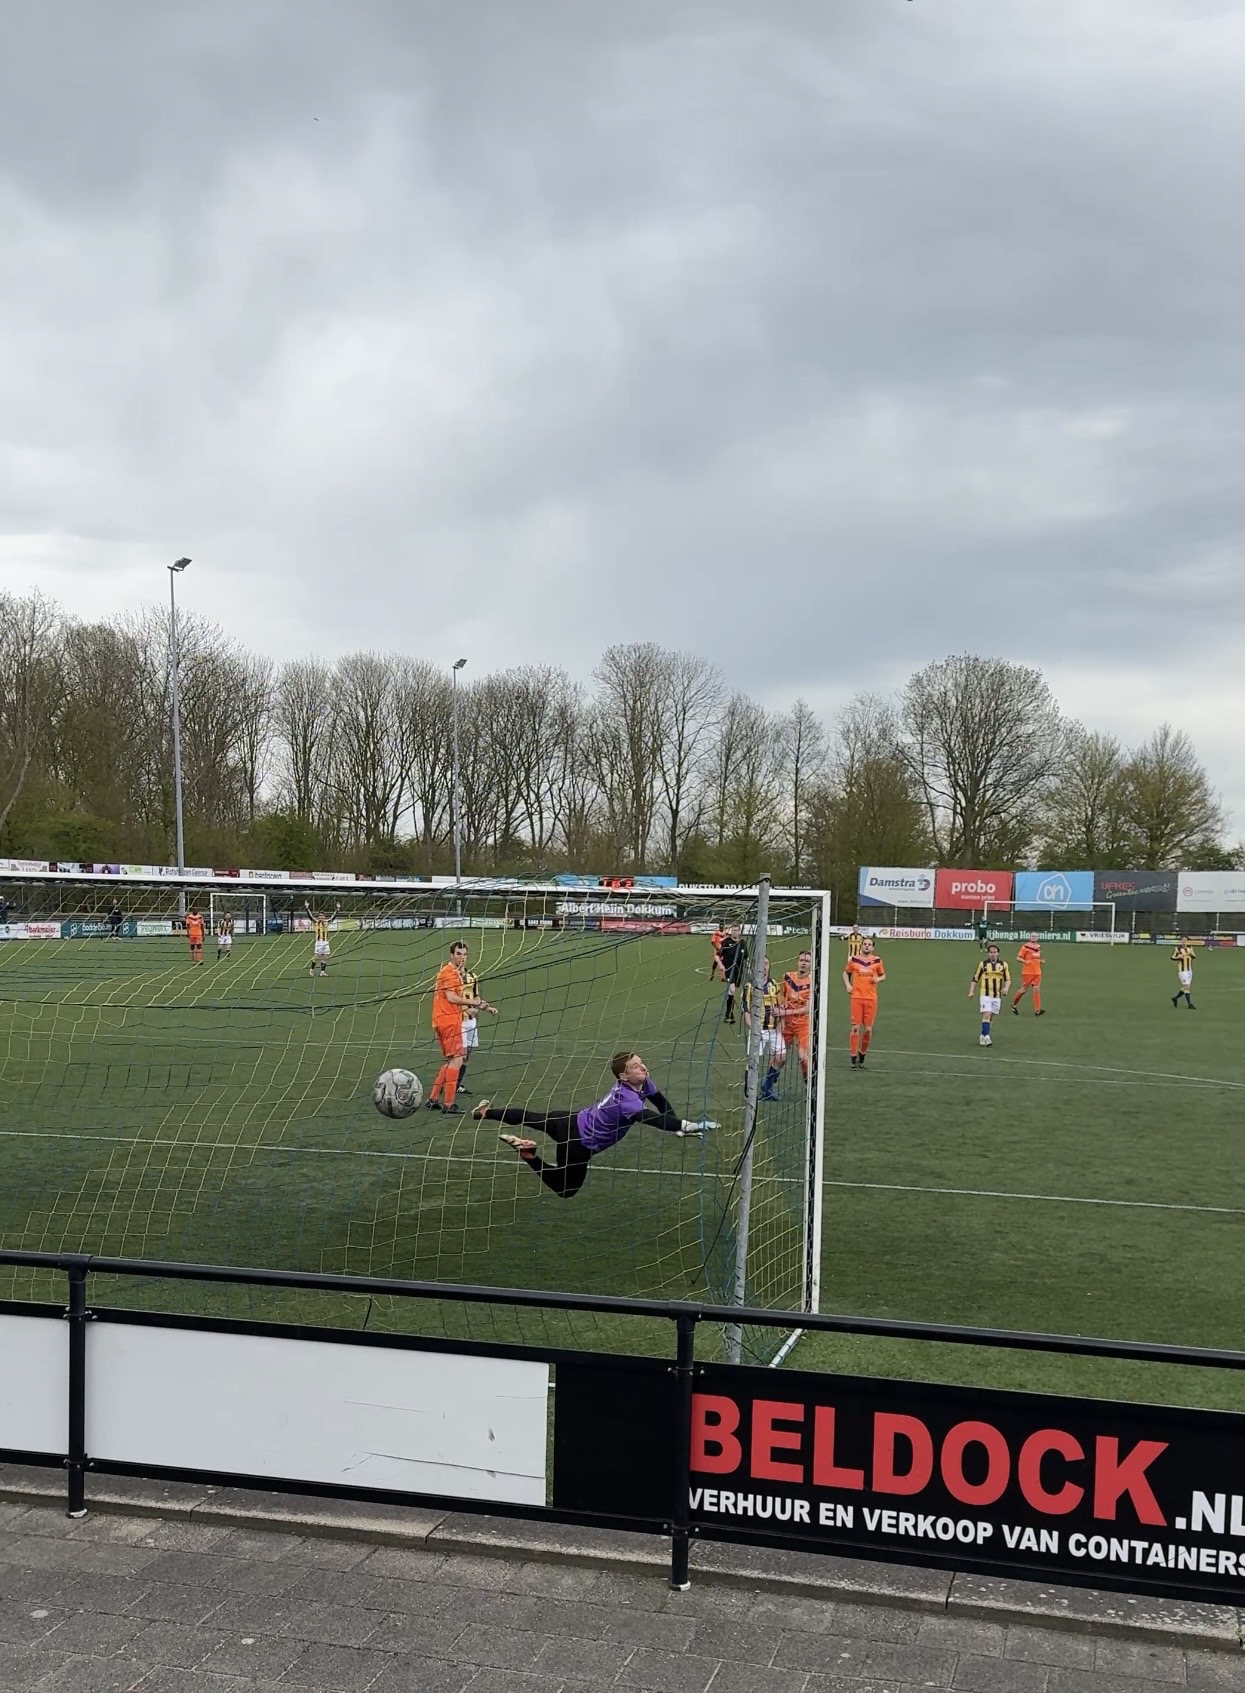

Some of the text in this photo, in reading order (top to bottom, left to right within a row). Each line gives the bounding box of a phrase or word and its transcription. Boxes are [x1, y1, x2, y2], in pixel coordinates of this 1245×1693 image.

[869, 877, 915, 888] Damstra
[951, 880, 996, 895] probo
[561, 902, 672, 915] Albert Heijn Dokkum
[889, 928, 973, 939] Reisburo Dokkum
[688, 1487, 811, 1523] VERHUUR
[819, 1502, 854, 1529] EN
[862, 1507, 994, 1545] VERKOOP
[1001, 1524, 1059, 1554] VAN
